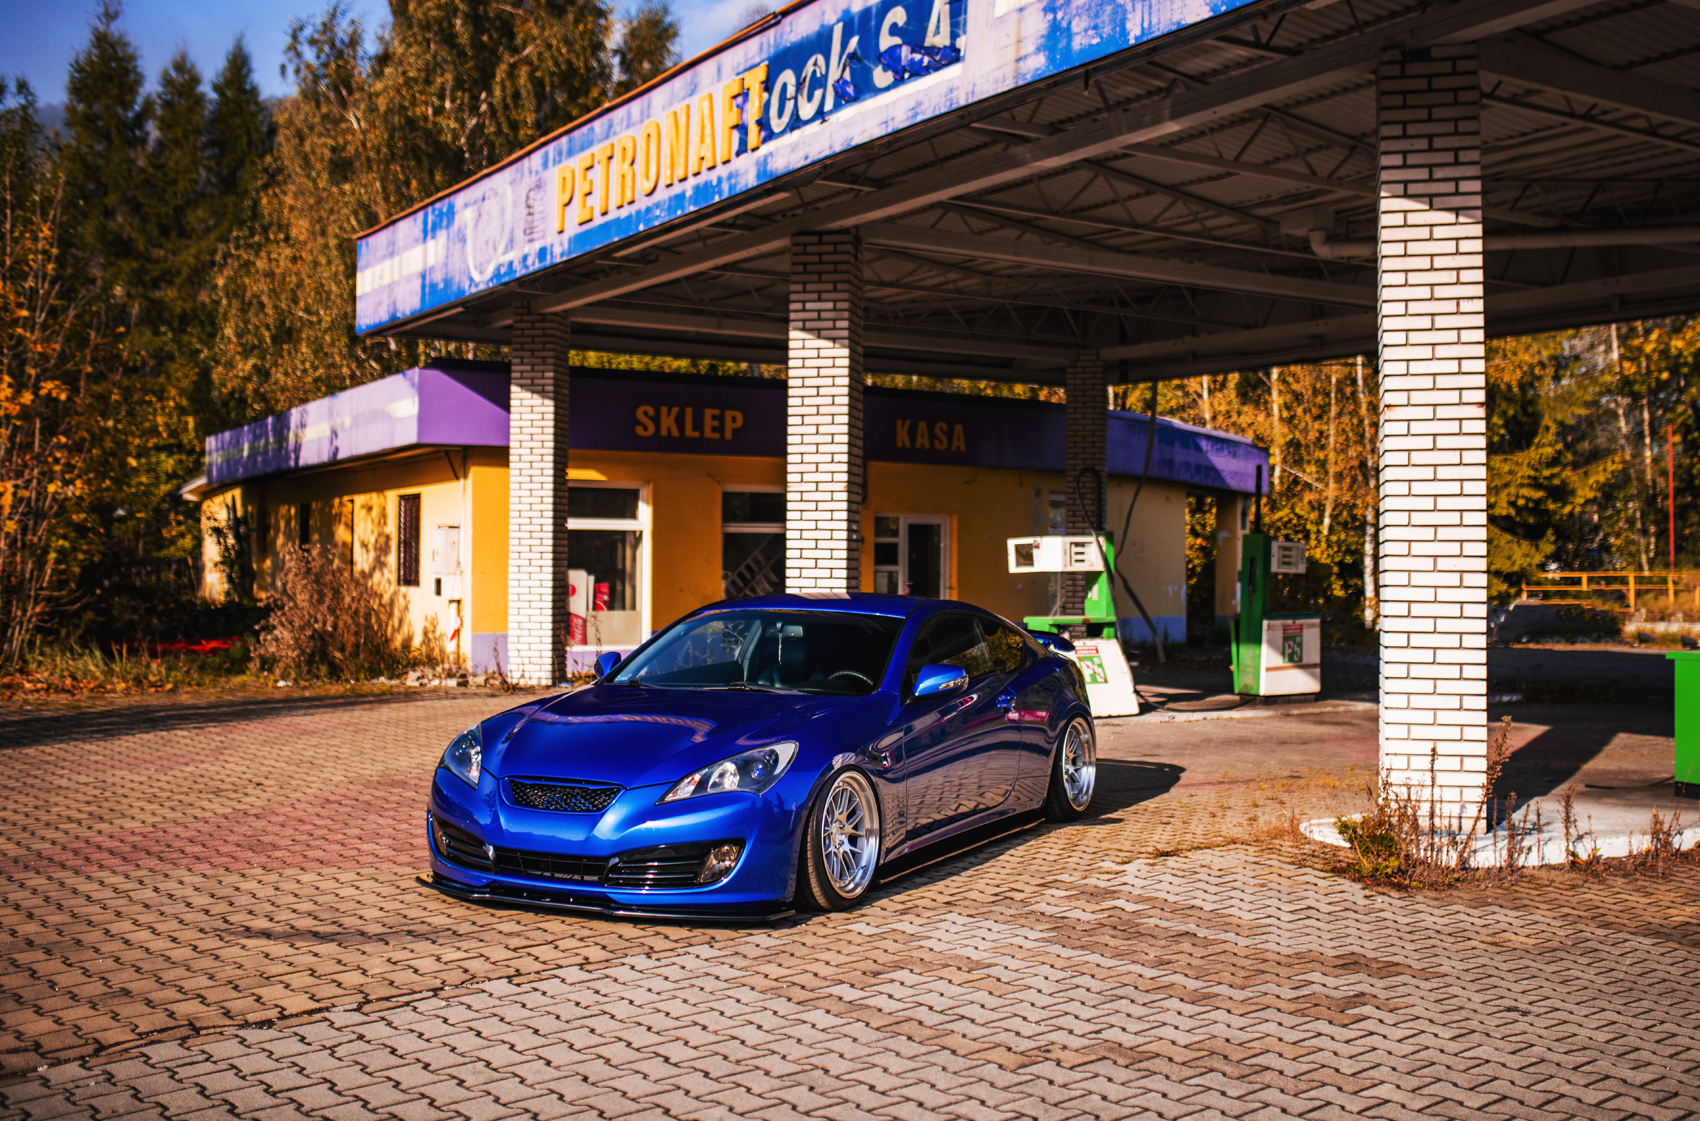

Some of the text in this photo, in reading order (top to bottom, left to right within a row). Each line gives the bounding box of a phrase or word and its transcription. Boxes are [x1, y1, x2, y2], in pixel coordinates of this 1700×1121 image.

[555, 64, 768, 233] PETRONAFT
[635, 405, 744, 440] SKLEP
[896, 419, 966, 452] KASA
